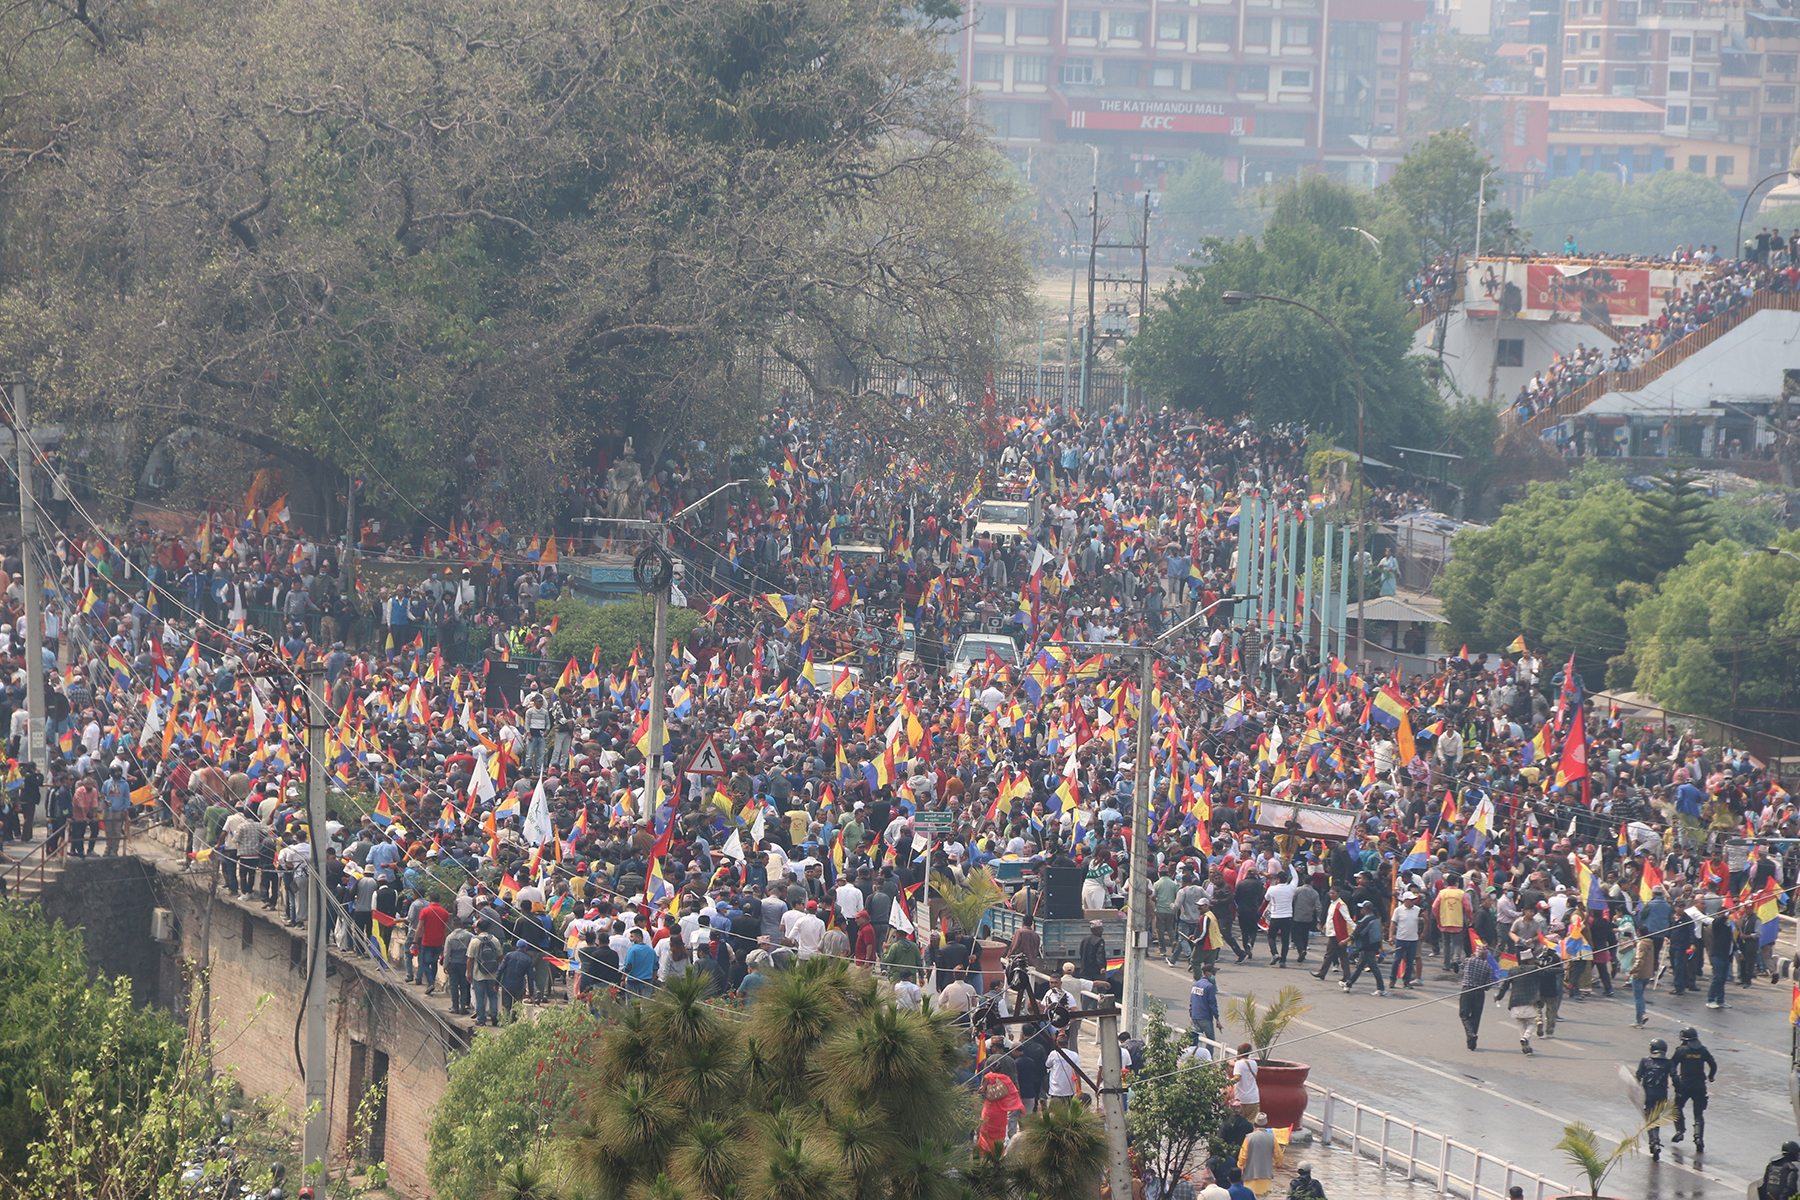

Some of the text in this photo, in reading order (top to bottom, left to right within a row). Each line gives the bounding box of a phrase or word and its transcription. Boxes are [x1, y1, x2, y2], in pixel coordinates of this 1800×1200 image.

[1100, 99, 1225, 115] THE KATHMANDU MALL
[1140, 115, 1175, 129] KFC
